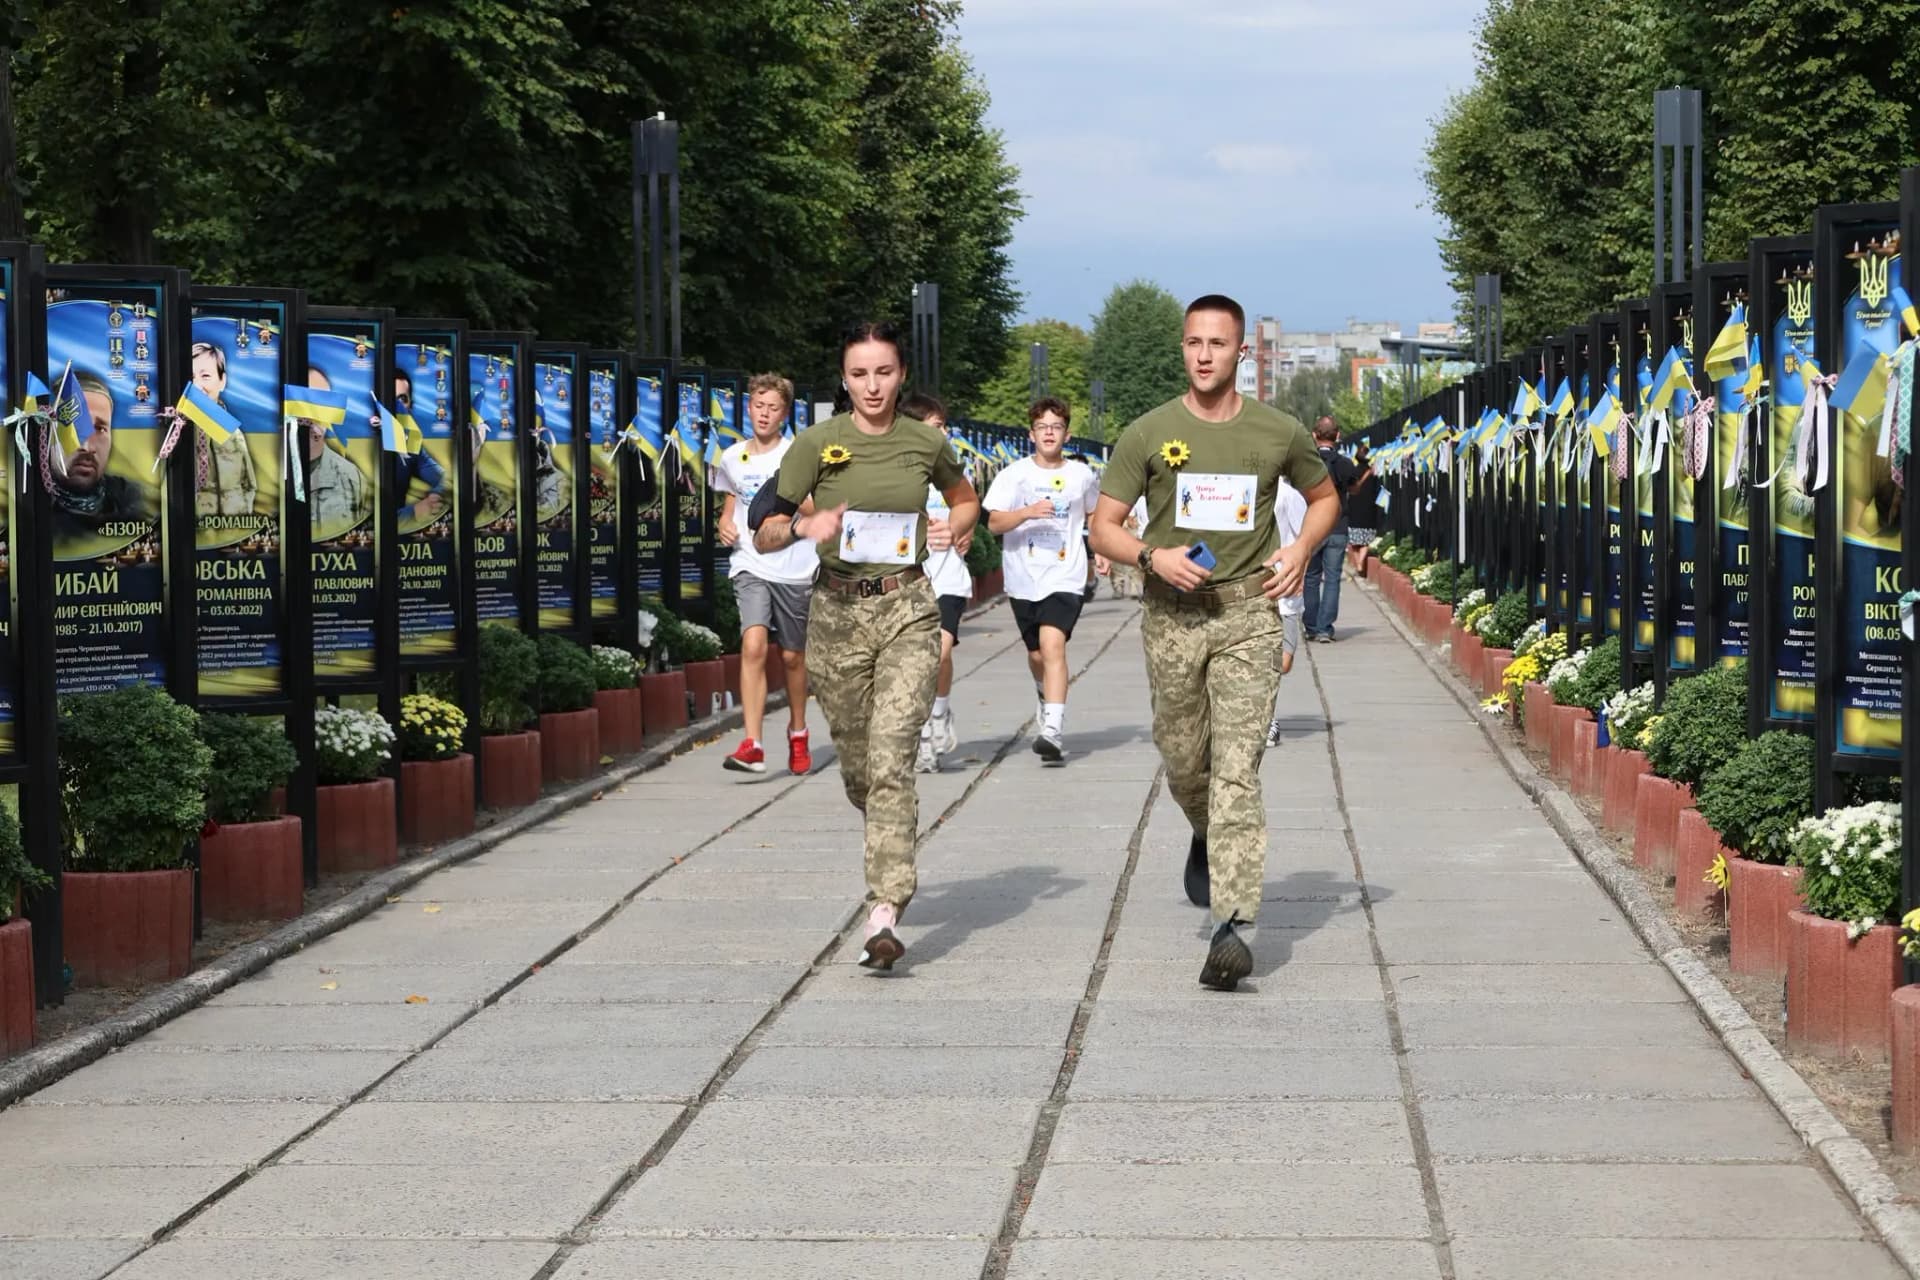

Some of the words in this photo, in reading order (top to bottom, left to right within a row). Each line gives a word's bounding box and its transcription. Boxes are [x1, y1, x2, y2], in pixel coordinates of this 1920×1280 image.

[97, 521, 153, 537] «БІЗОН»
[198, 515, 274, 529] «РОМАШКА»
[55, 565, 119, 596] ИБАЙ
[314, 577, 374, 590] ПАВЛОВИЧ
[196, 587, 273, 600] РОМАНІВНА
[80, 600, 162, 618] ЄВГЕНІЙОВИЧ
[1865, 603, 1901, 620] ВІКТ
[55, 624, 78, 636] 1985
[88, 620, 143, 635] 21.10.2017)
